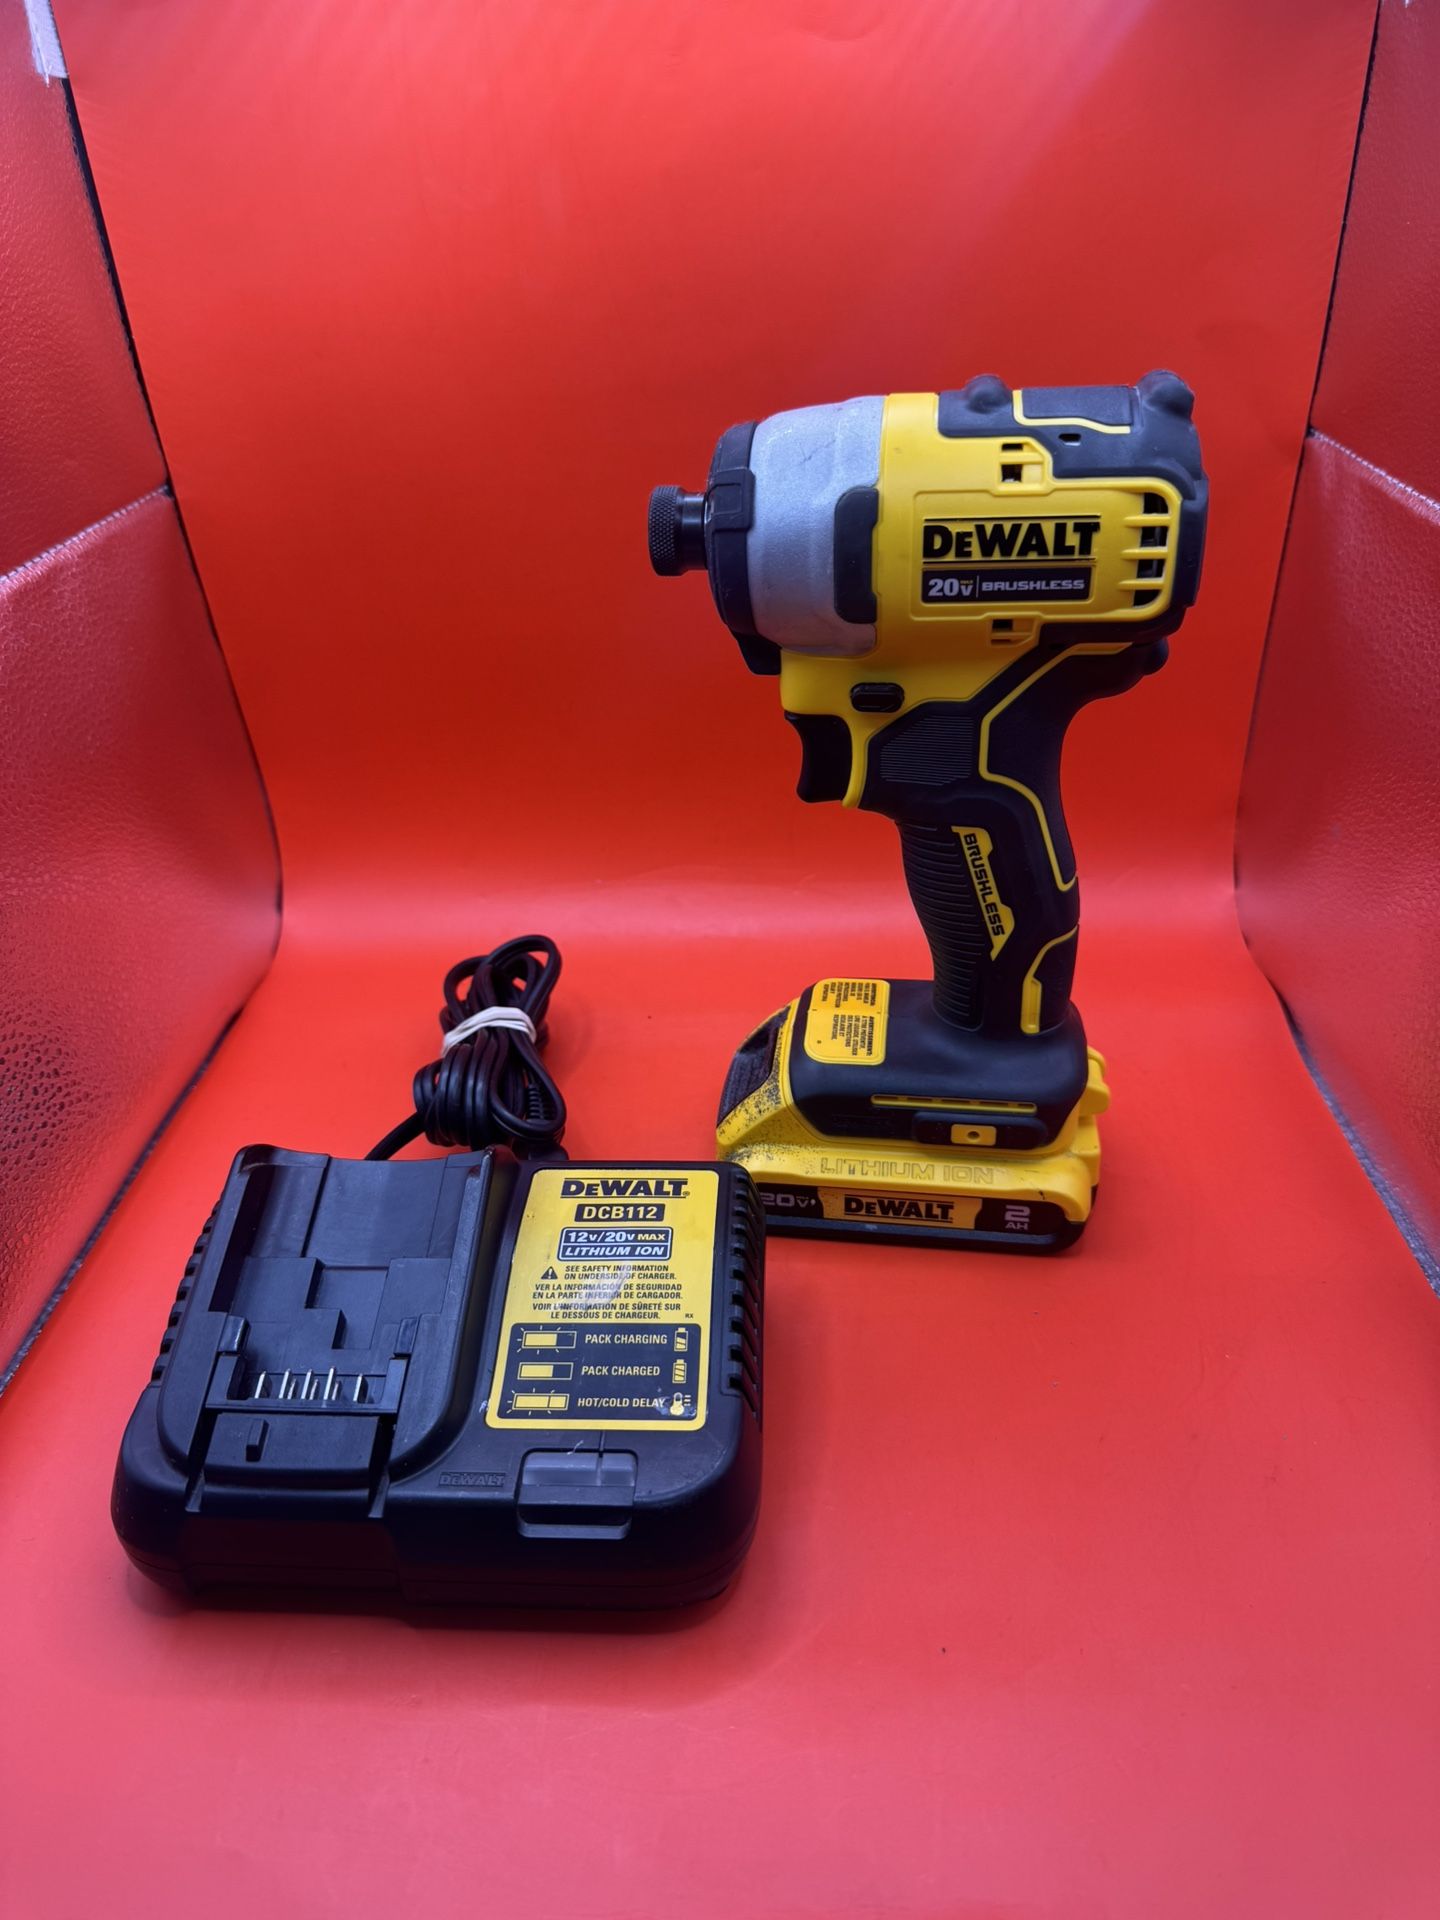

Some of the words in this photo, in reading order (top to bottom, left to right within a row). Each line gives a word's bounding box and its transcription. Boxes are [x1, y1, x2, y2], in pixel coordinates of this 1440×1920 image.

[923, 522, 1101, 558] DEWALT
[981, 579, 1086, 592] BRUSHLESS
[963, 832, 1006, 937] BRUSHLESS
[820, 1157, 935, 1181] LITHIUM
[943, 1165, 994, 1184] ION
[582, 1205, 658, 1220] DCB112
[844, 1195, 955, 1221] DEWALT
[1005, 1204, 1031, 1222] 2
[1005, 1221, 1029, 1230] AH
[637, 1233, 666, 1242] MAX
[565, 1246, 633, 1256] LITHIUM
[635, 1246, 665, 1256] ION
[613, 1264, 669, 1272] INFORMATION
[535, 1283, 550, 1291] VER
[552, 1283, 563, 1291] LA
[623, 1283, 634, 1291] DE
[635, 1283, 682, 1291] SEGURIDAD
[532, 1302, 552, 1310] VOIR
[619, 1302, 630, 1310] DE
[632, 1301, 662, 1310] SÛRETÉ
[664, 1302, 681, 1310] SUR
[585, 1334, 611, 1344] PACK
[614, 1334, 668, 1345] CHARGING
[581, 1366, 609, 1376] PACK
[611, 1365, 660, 1376] CHARGED
[577, 1397, 630, 1408] HOT/COLD
[632, 1397, 665, 1408] DELAY
